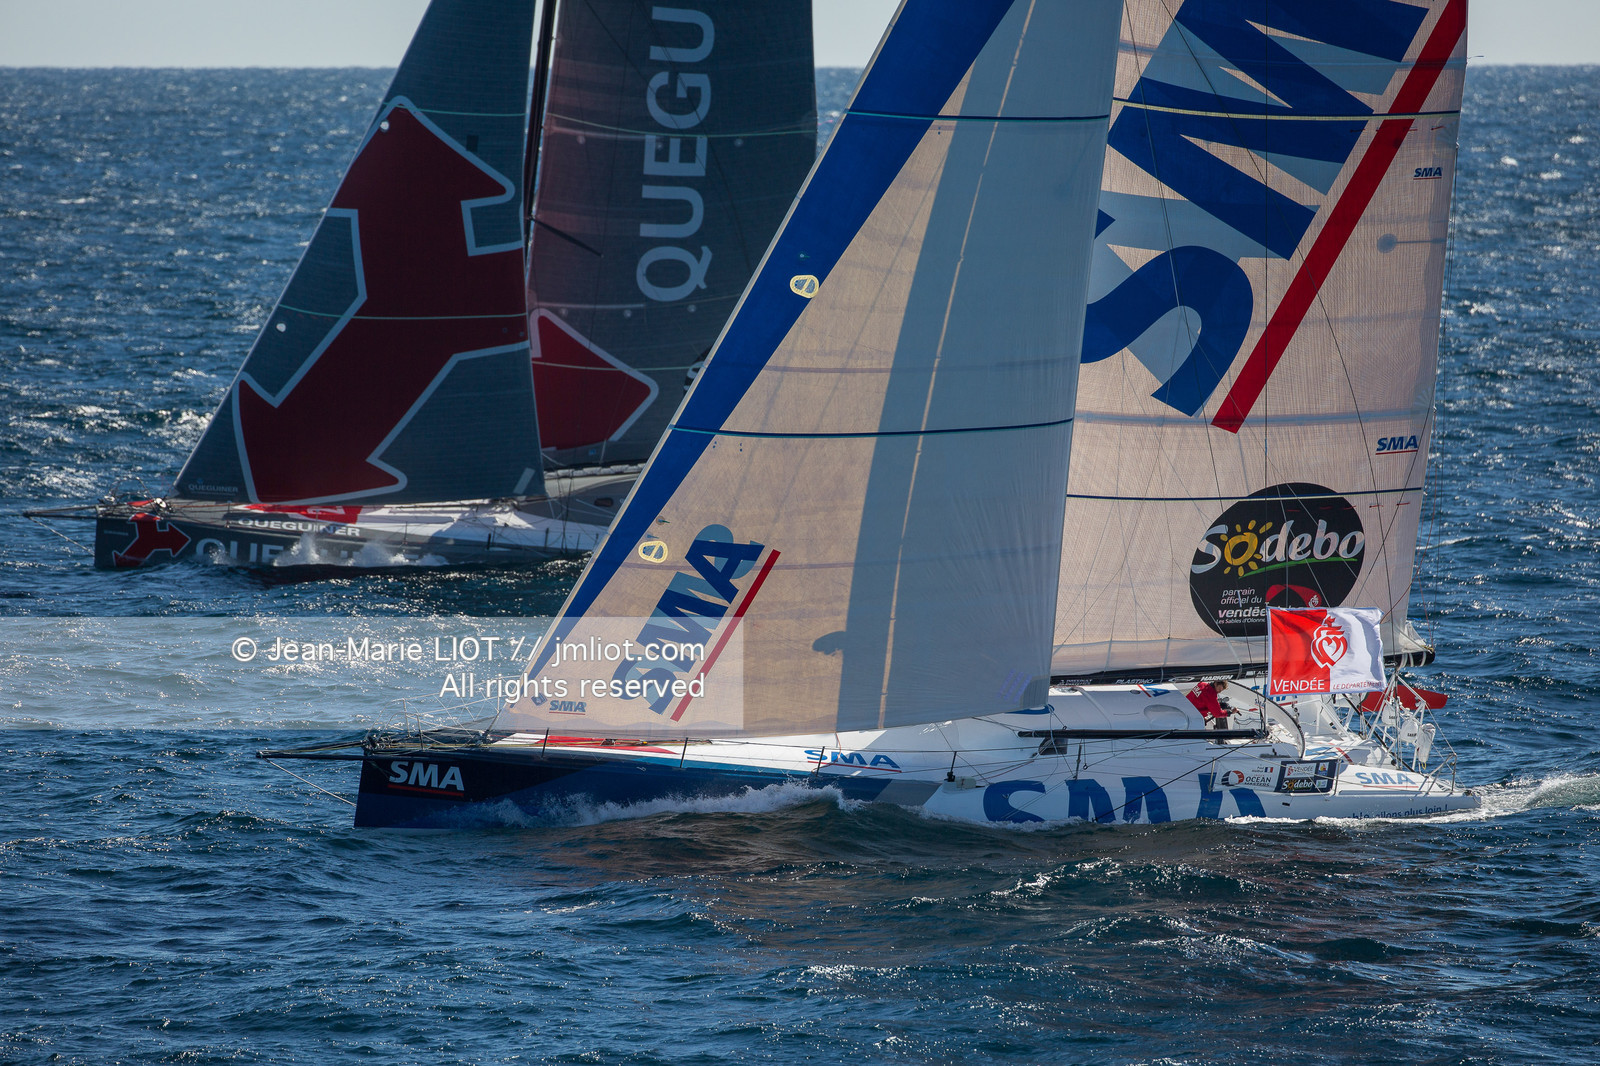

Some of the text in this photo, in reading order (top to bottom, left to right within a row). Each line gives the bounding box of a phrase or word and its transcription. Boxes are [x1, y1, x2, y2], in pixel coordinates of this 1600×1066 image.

[1414, 167, 1443, 178] SMA
[1376, 435, 1418, 451] SMA
[238, 517, 361, 537] QUEGUINER
[1191, 519, 1365, 574] Sodebo
[1222, 587, 1255, 597] parrain
[1251, 596, 1263, 604] du
[612, 526, 765, 715] SMA
[1273, 677, 1325, 692] VENDÉE
[549, 700, 587, 712] SMA
[804, 749, 900, 769] SMA
[389, 760, 465, 791] SMA
[1355, 772, 1417, 785] SMA
[1281, 779, 1313, 790] Sodebo
